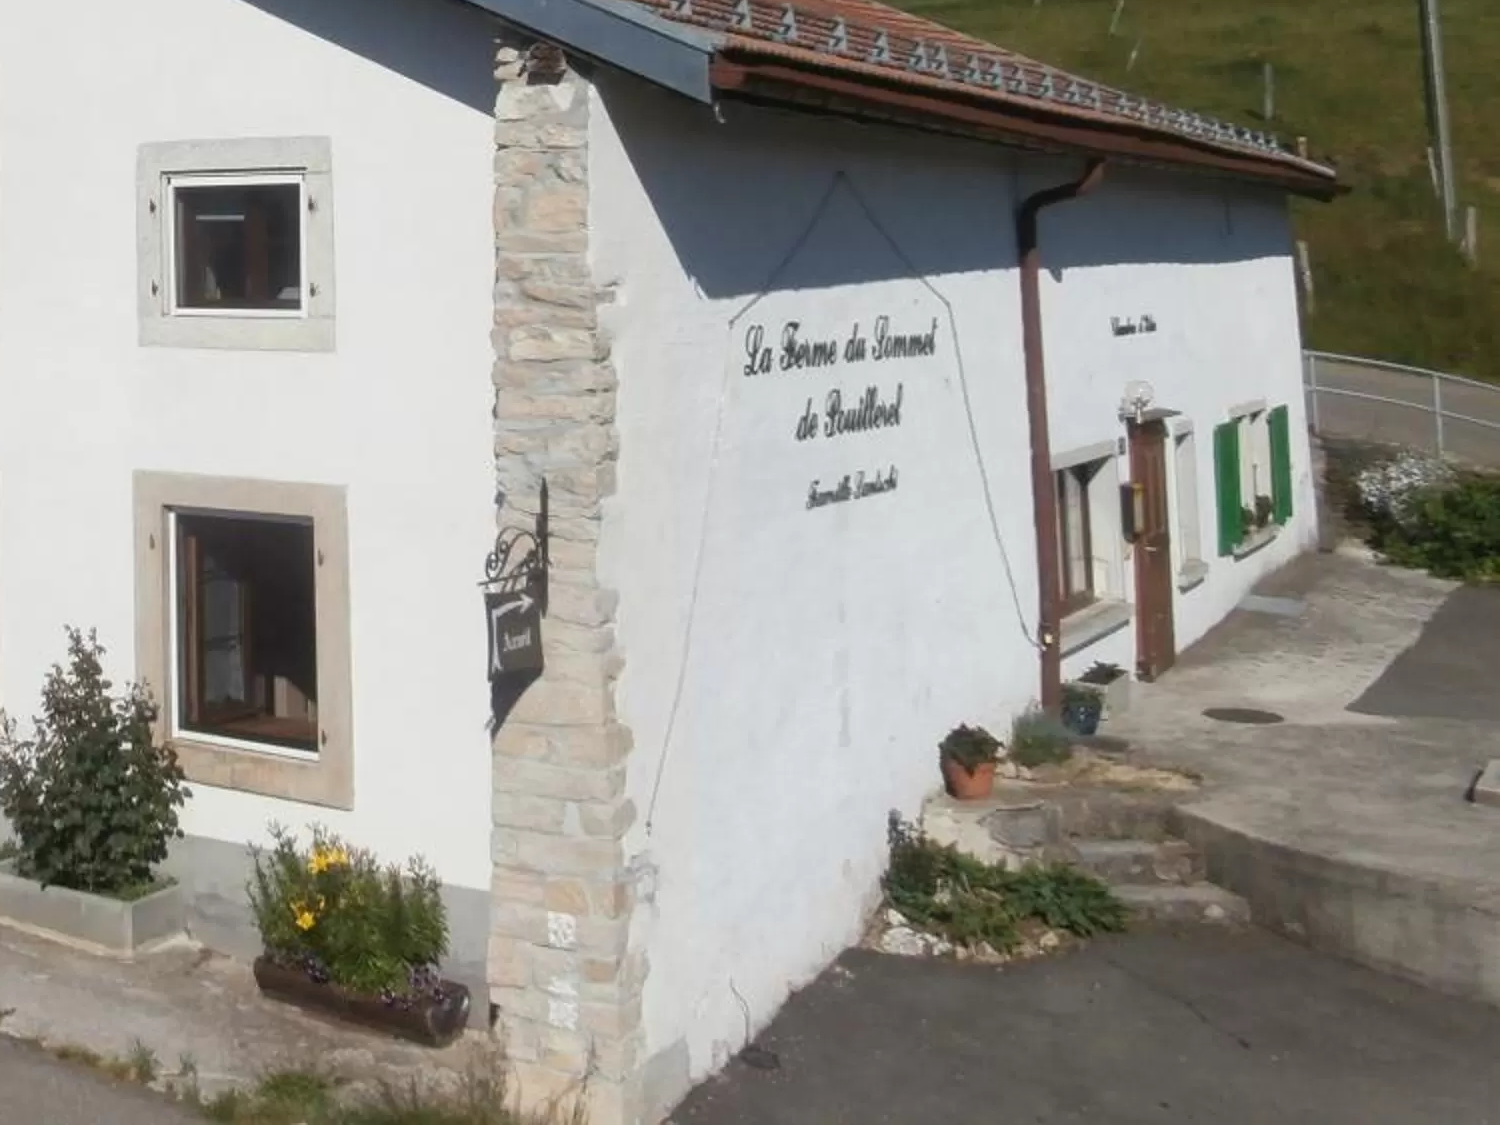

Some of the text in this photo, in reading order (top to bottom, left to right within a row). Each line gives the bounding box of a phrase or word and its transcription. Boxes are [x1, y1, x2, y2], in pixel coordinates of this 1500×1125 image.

[744, 315, 938, 376] La Ferme du Sommet
[794, 396, 818, 441] de
